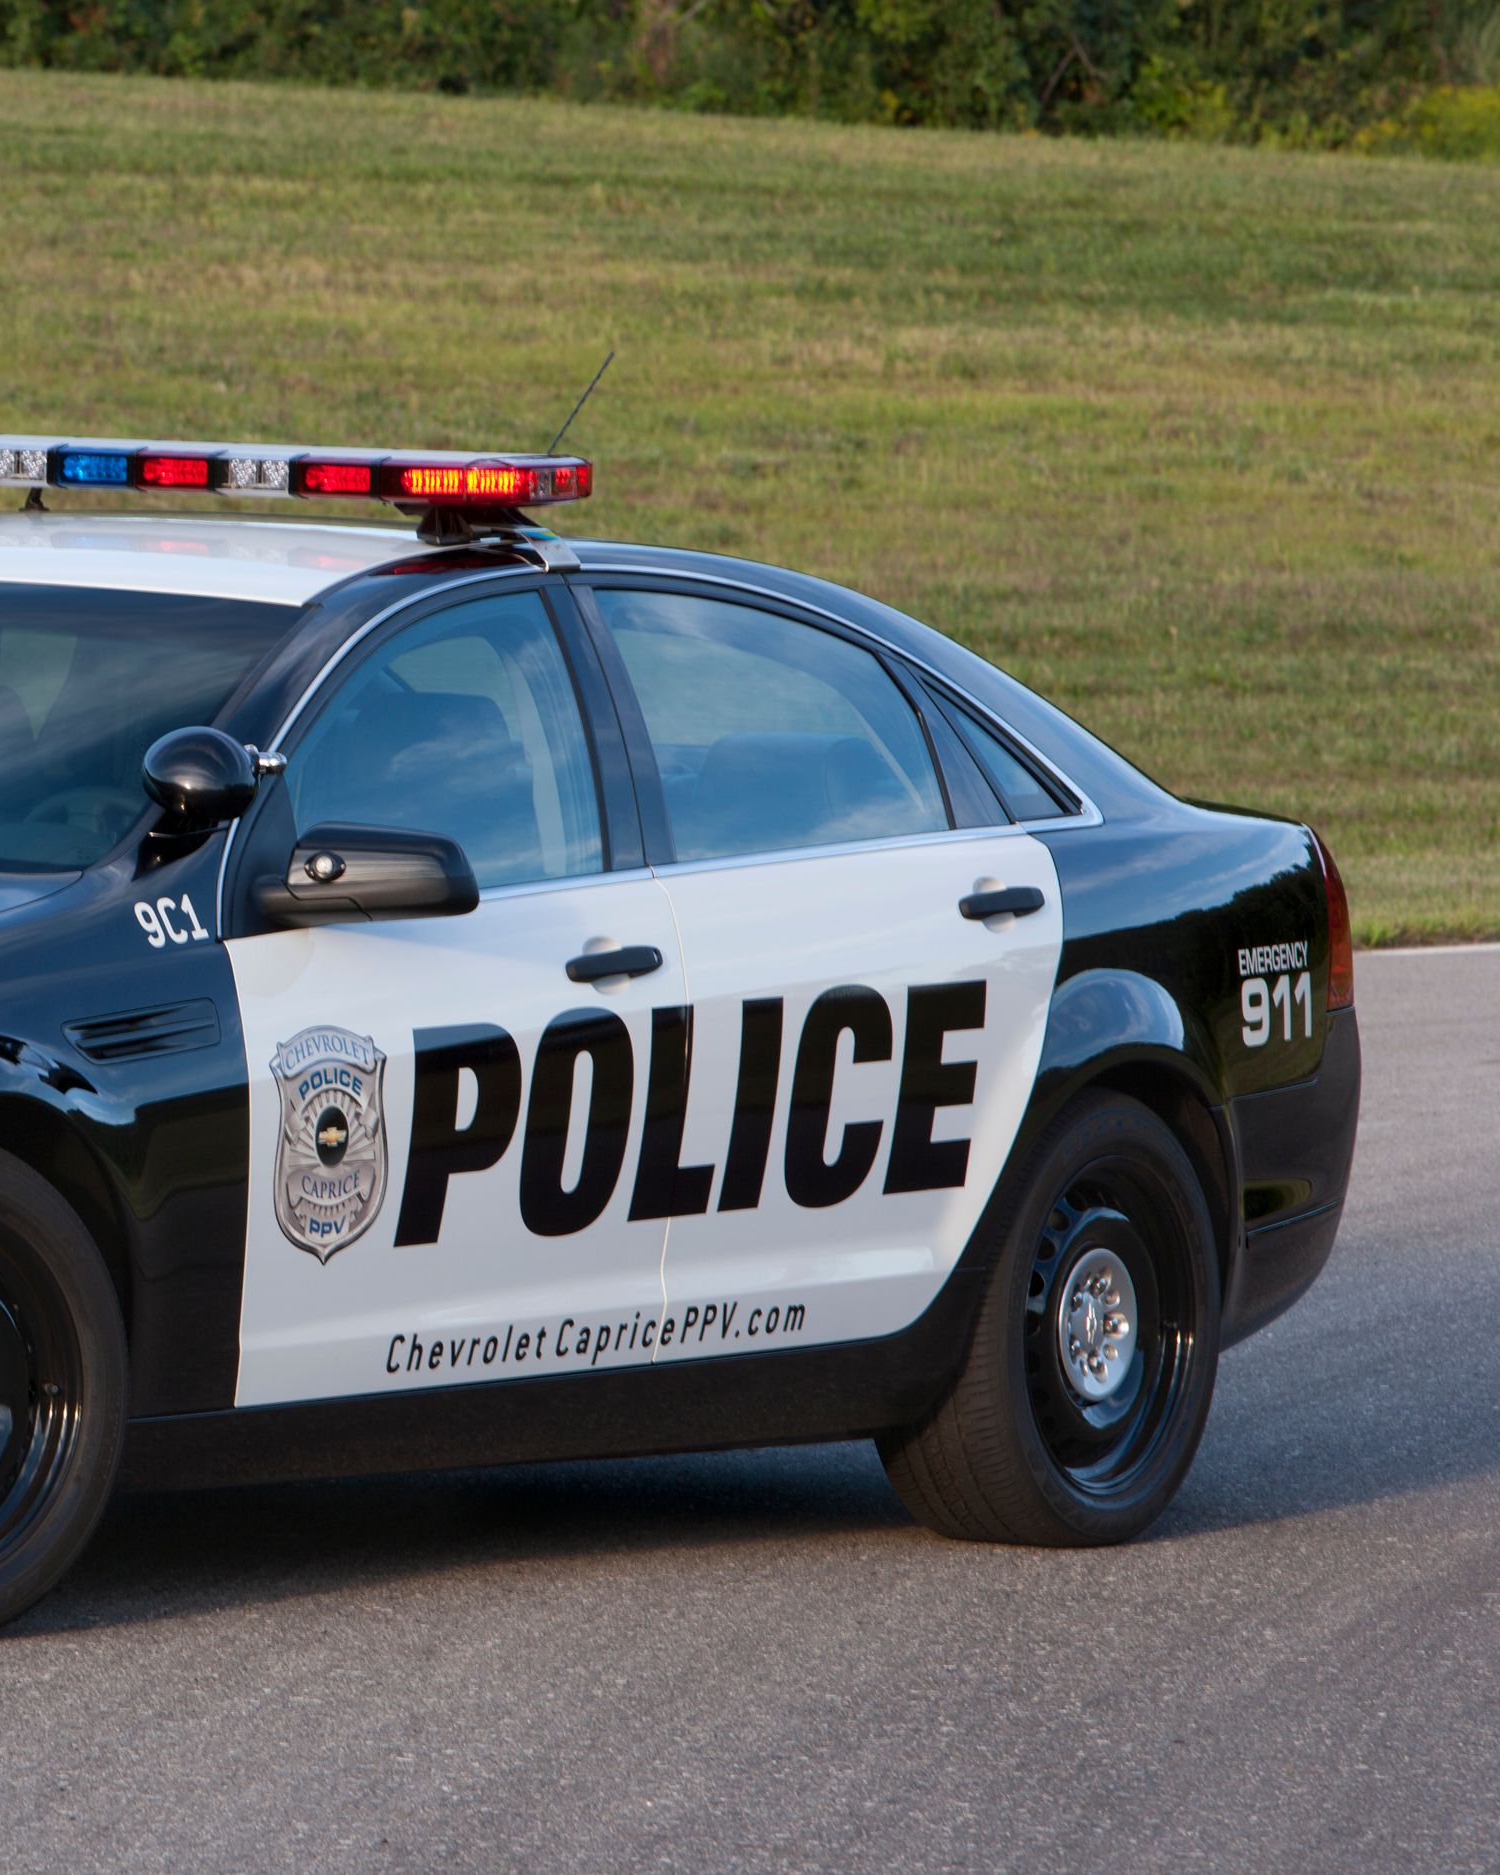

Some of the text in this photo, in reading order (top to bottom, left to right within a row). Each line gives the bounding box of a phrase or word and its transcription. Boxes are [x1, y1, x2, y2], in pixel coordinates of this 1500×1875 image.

[133, 893, 210, 949] 9C1
[1238, 940, 1308, 977] EMERGENCY
[1241, 971, 1312, 1049] 911
[285, 1035, 371, 1071] CHEVROLET
[297, 1067, 363, 1101] POLICE
[393, 979, 988, 1248] POLICE
[301, 1169, 361, 1198] CAPRICE
[308, 1217, 346, 1238] PPV
[386, 1301, 807, 1374] ChevroletCapricePPV.com
